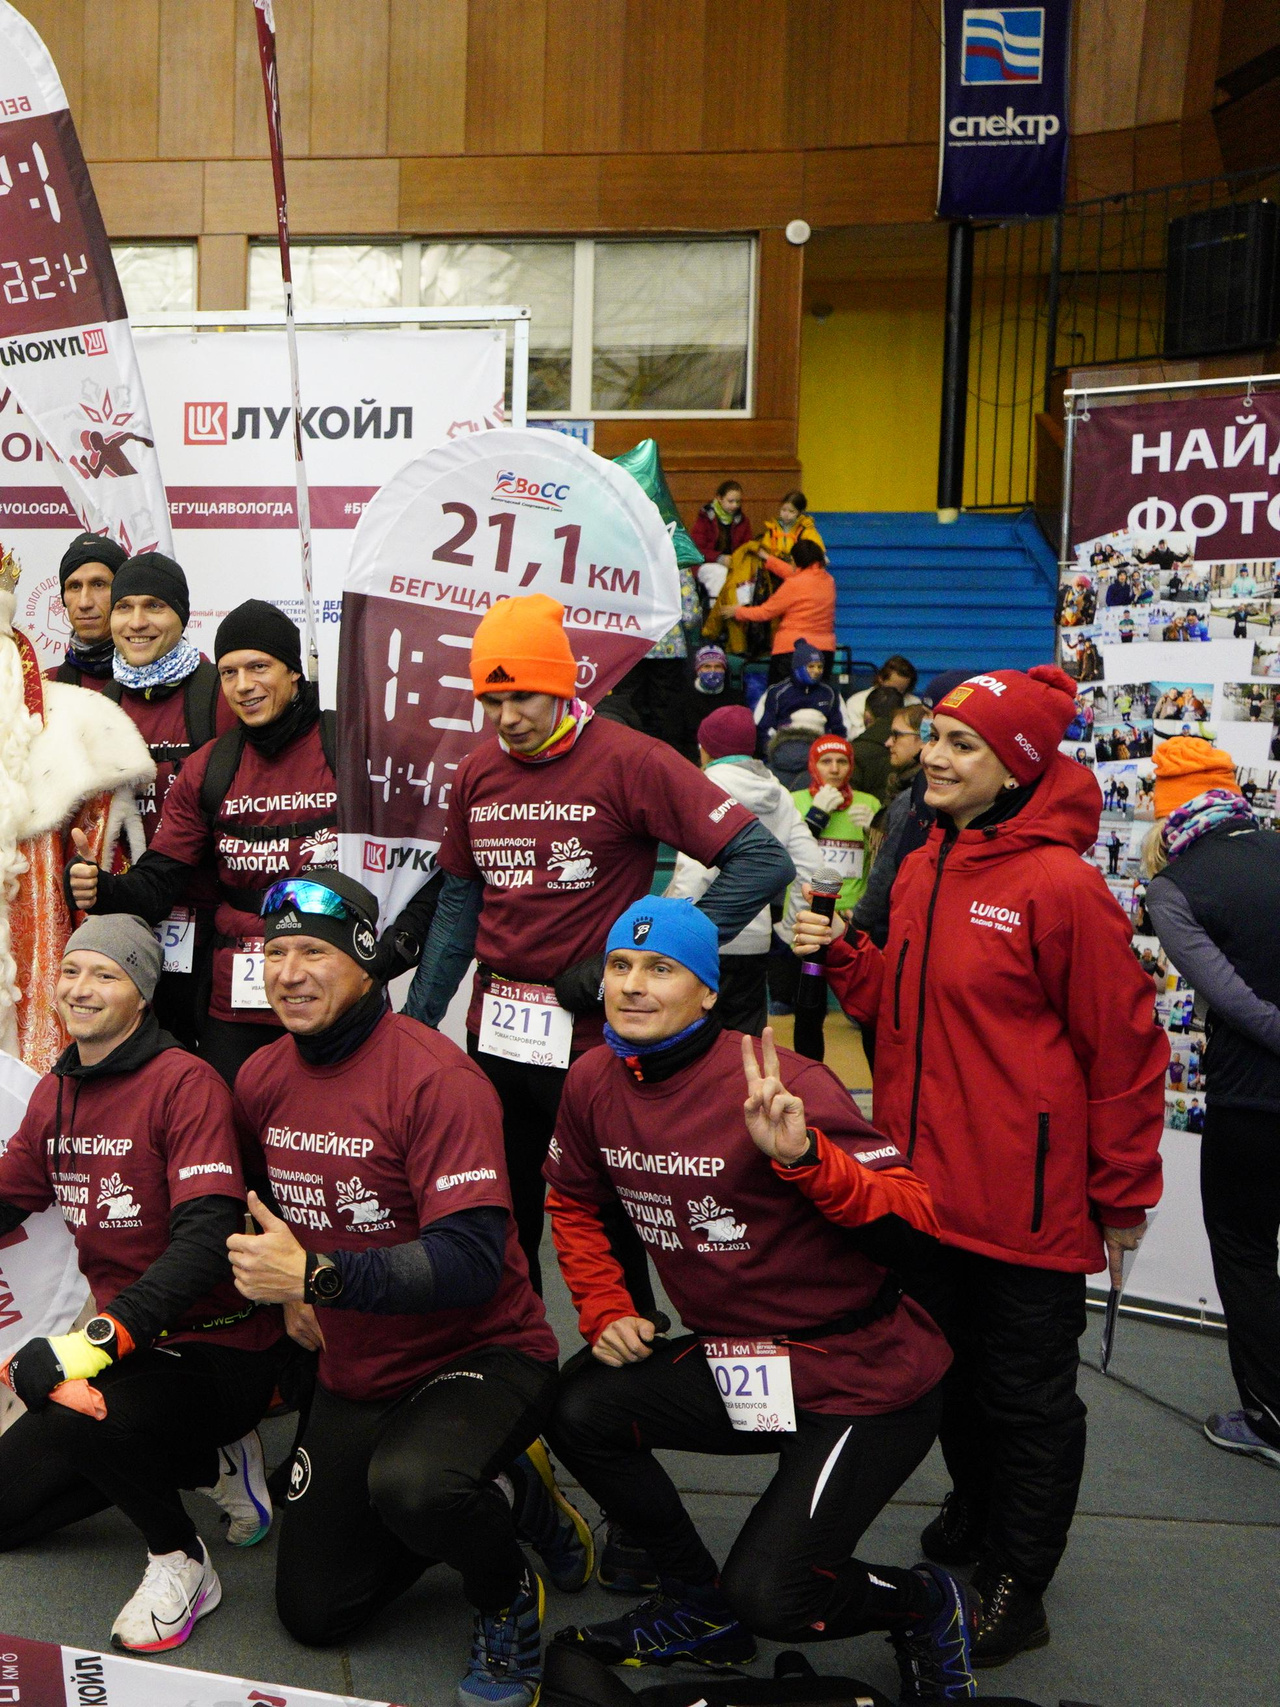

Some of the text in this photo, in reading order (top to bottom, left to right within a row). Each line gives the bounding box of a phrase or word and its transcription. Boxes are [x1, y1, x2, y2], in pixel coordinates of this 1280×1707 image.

[949, 106, 1060, 145] спектр
[231, 398, 413, 441] ЛУКОЙЛ
[1131, 414, 1280, 475] НАЙ
[167, 502, 293, 516] БЕГУЩАЯВОЛОГДА
[1127, 491, 1280, 537] ФОТ
[432, 502, 640, 596] 21,1 КМ
[563, 604, 641, 631] ЛОГДА
[385, 628, 484, 733] 1:3
[221, 791, 337, 816] ПЕЙСМЕЙКЕР
[470, 800, 596, 822] ПЕЙСМЕЙКЕР
[219, 837, 290, 855] БЕГУЩАЯ
[474, 838, 536, 847] ПОЛУМАРАФОН
[547, 881, 595, 890] 05.12.2021
[970, 901, 1021, 926] LUKOIL
[276, 922, 302, 930] adidas
[501, 985, 520, 1000] 21,1
[492, 1001, 552, 1036] 2211
[47, 1135, 133, 1157] ПЙСМЕЙКЕР
[266, 1127, 374, 1158] ПЕЙСМЕЙКЕР
[189, 1162, 233, 1176] ЛУКОЙЛ
[449, 1168, 497, 1187] ЛУКОЙЛ
[56, 1185, 89, 1204] ЕГУЩАЯ
[271, 1180, 326, 1207] ЕГУЩАЯ
[99, 1220, 143, 1229] 05.12.2021
[346, 1221, 396, 1233] 05.12.2021
[635, 1222, 683, 1251] ЛОГДА
[697, 1242, 751, 1252] 05.12.2021
[704, 1343, 728, 1357] 21,1
[715, 1365, 769, 1396] 021
[70, 1655, 108, 1707] КОЙЛ
